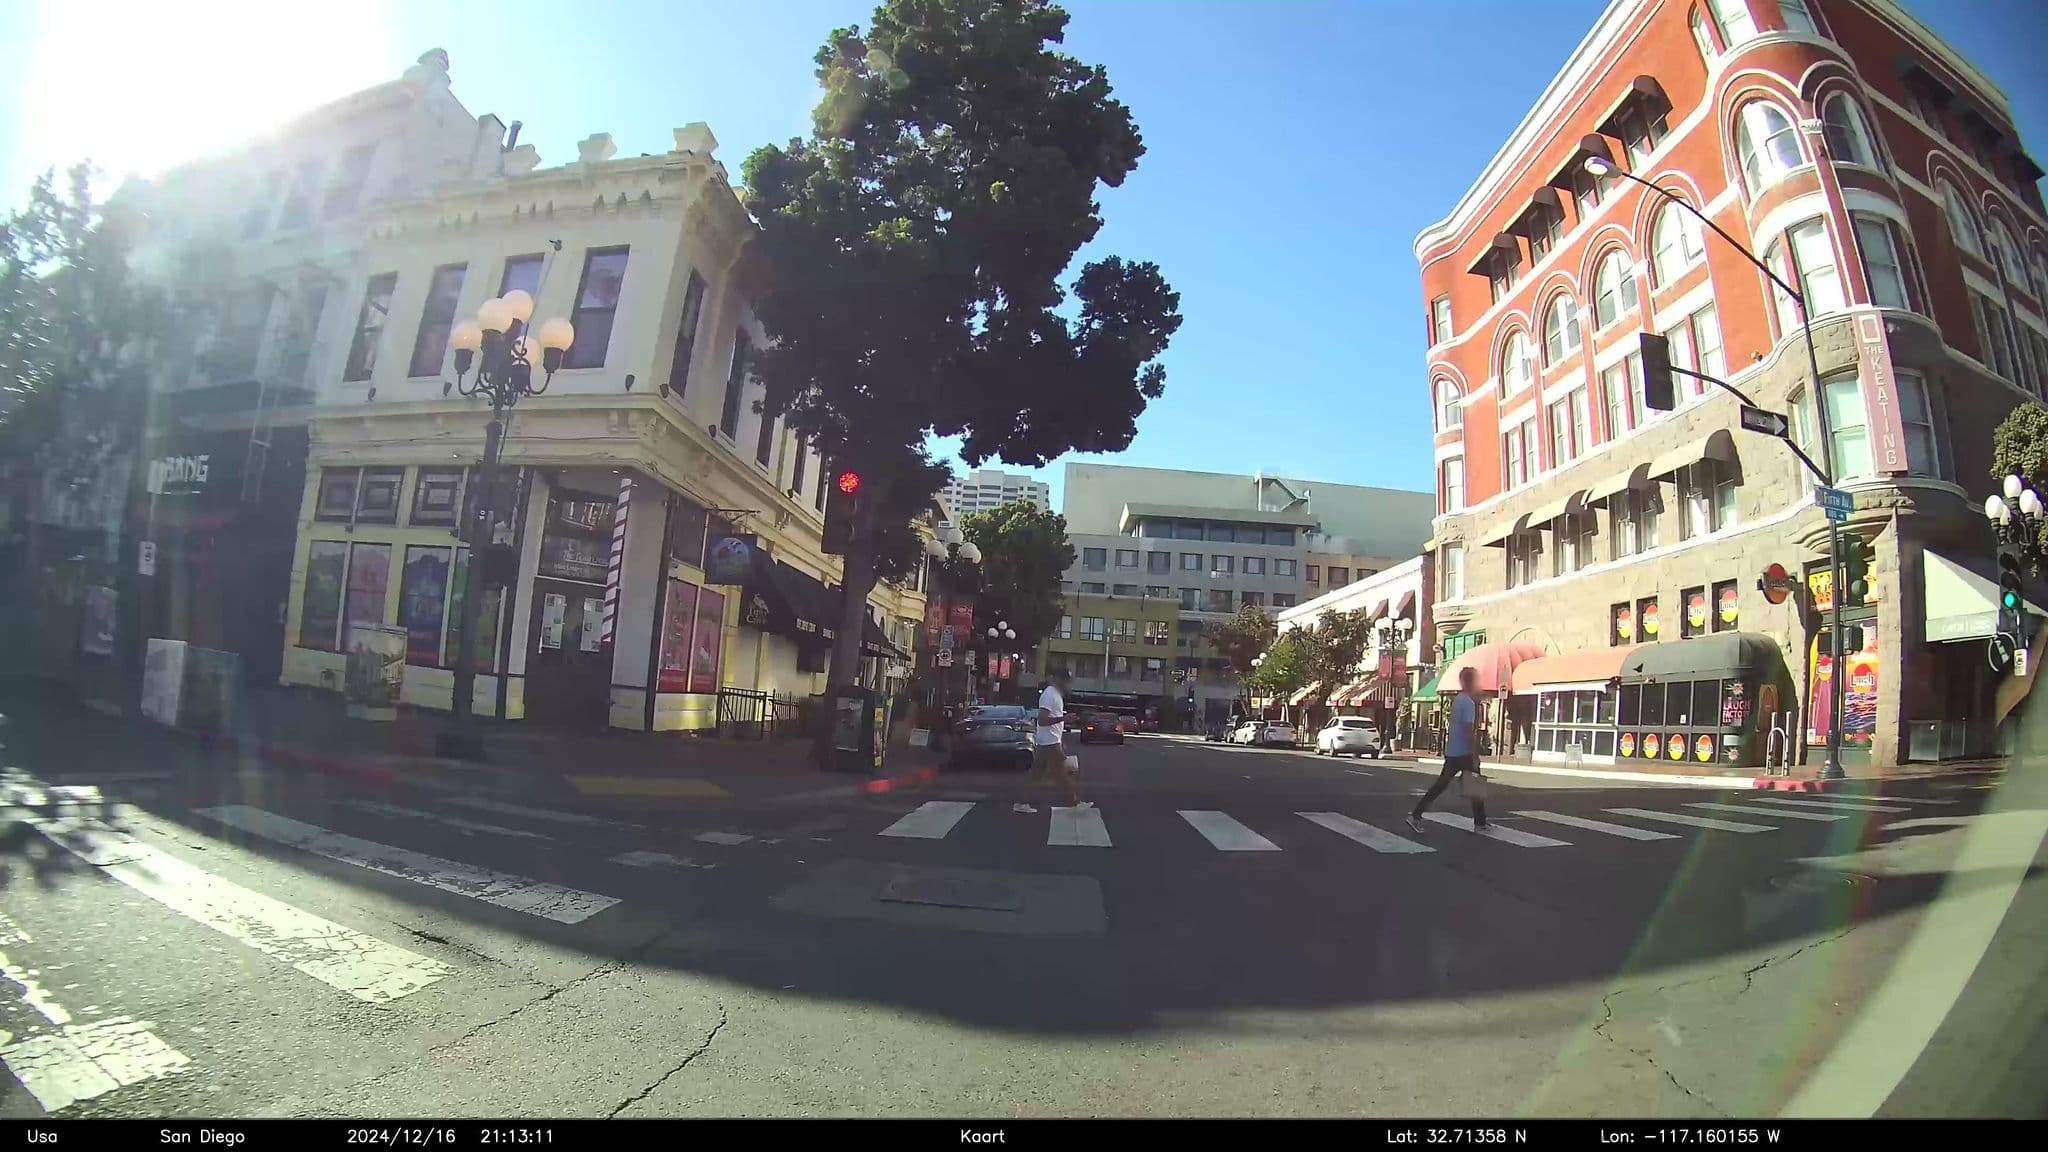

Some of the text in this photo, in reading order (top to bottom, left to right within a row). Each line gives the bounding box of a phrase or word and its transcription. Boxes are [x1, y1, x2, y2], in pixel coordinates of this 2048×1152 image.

[1864, 346, 1885, 355] THE
[1871, 356, 1897, 465] KEATING
[1823, 491, 1840, 506] FIFTH
[1723, 700, 1751, 710] LAUGH
